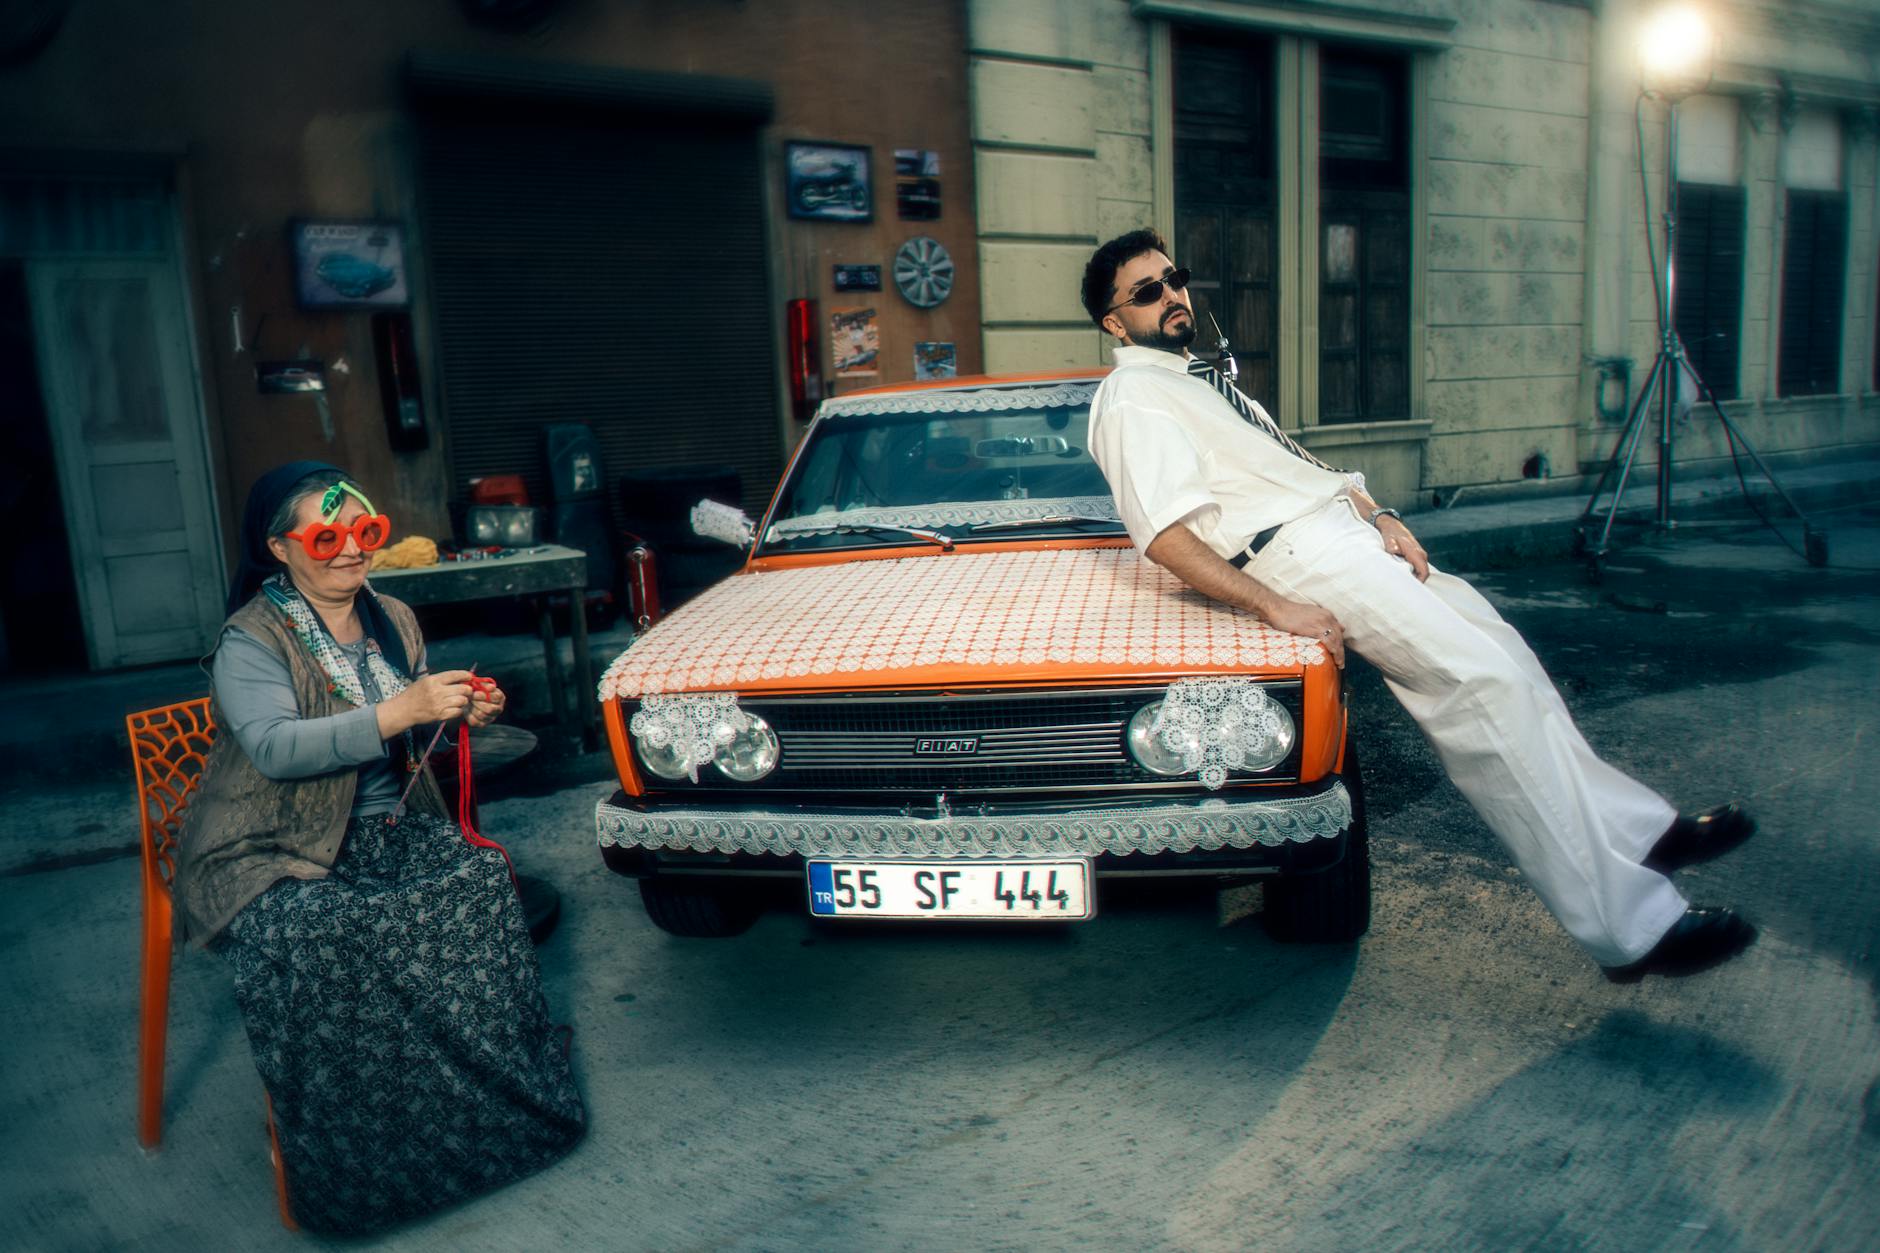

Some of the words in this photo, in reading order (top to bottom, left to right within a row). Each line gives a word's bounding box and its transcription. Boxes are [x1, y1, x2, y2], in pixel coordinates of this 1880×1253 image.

[921, 741, 973, 751] FIAT
[833, 869, 881, 909] 55
[914, 870, 961, 910] SF
[994, 870, 1069, 910] 444
[815, 891, 832, 904] TR
